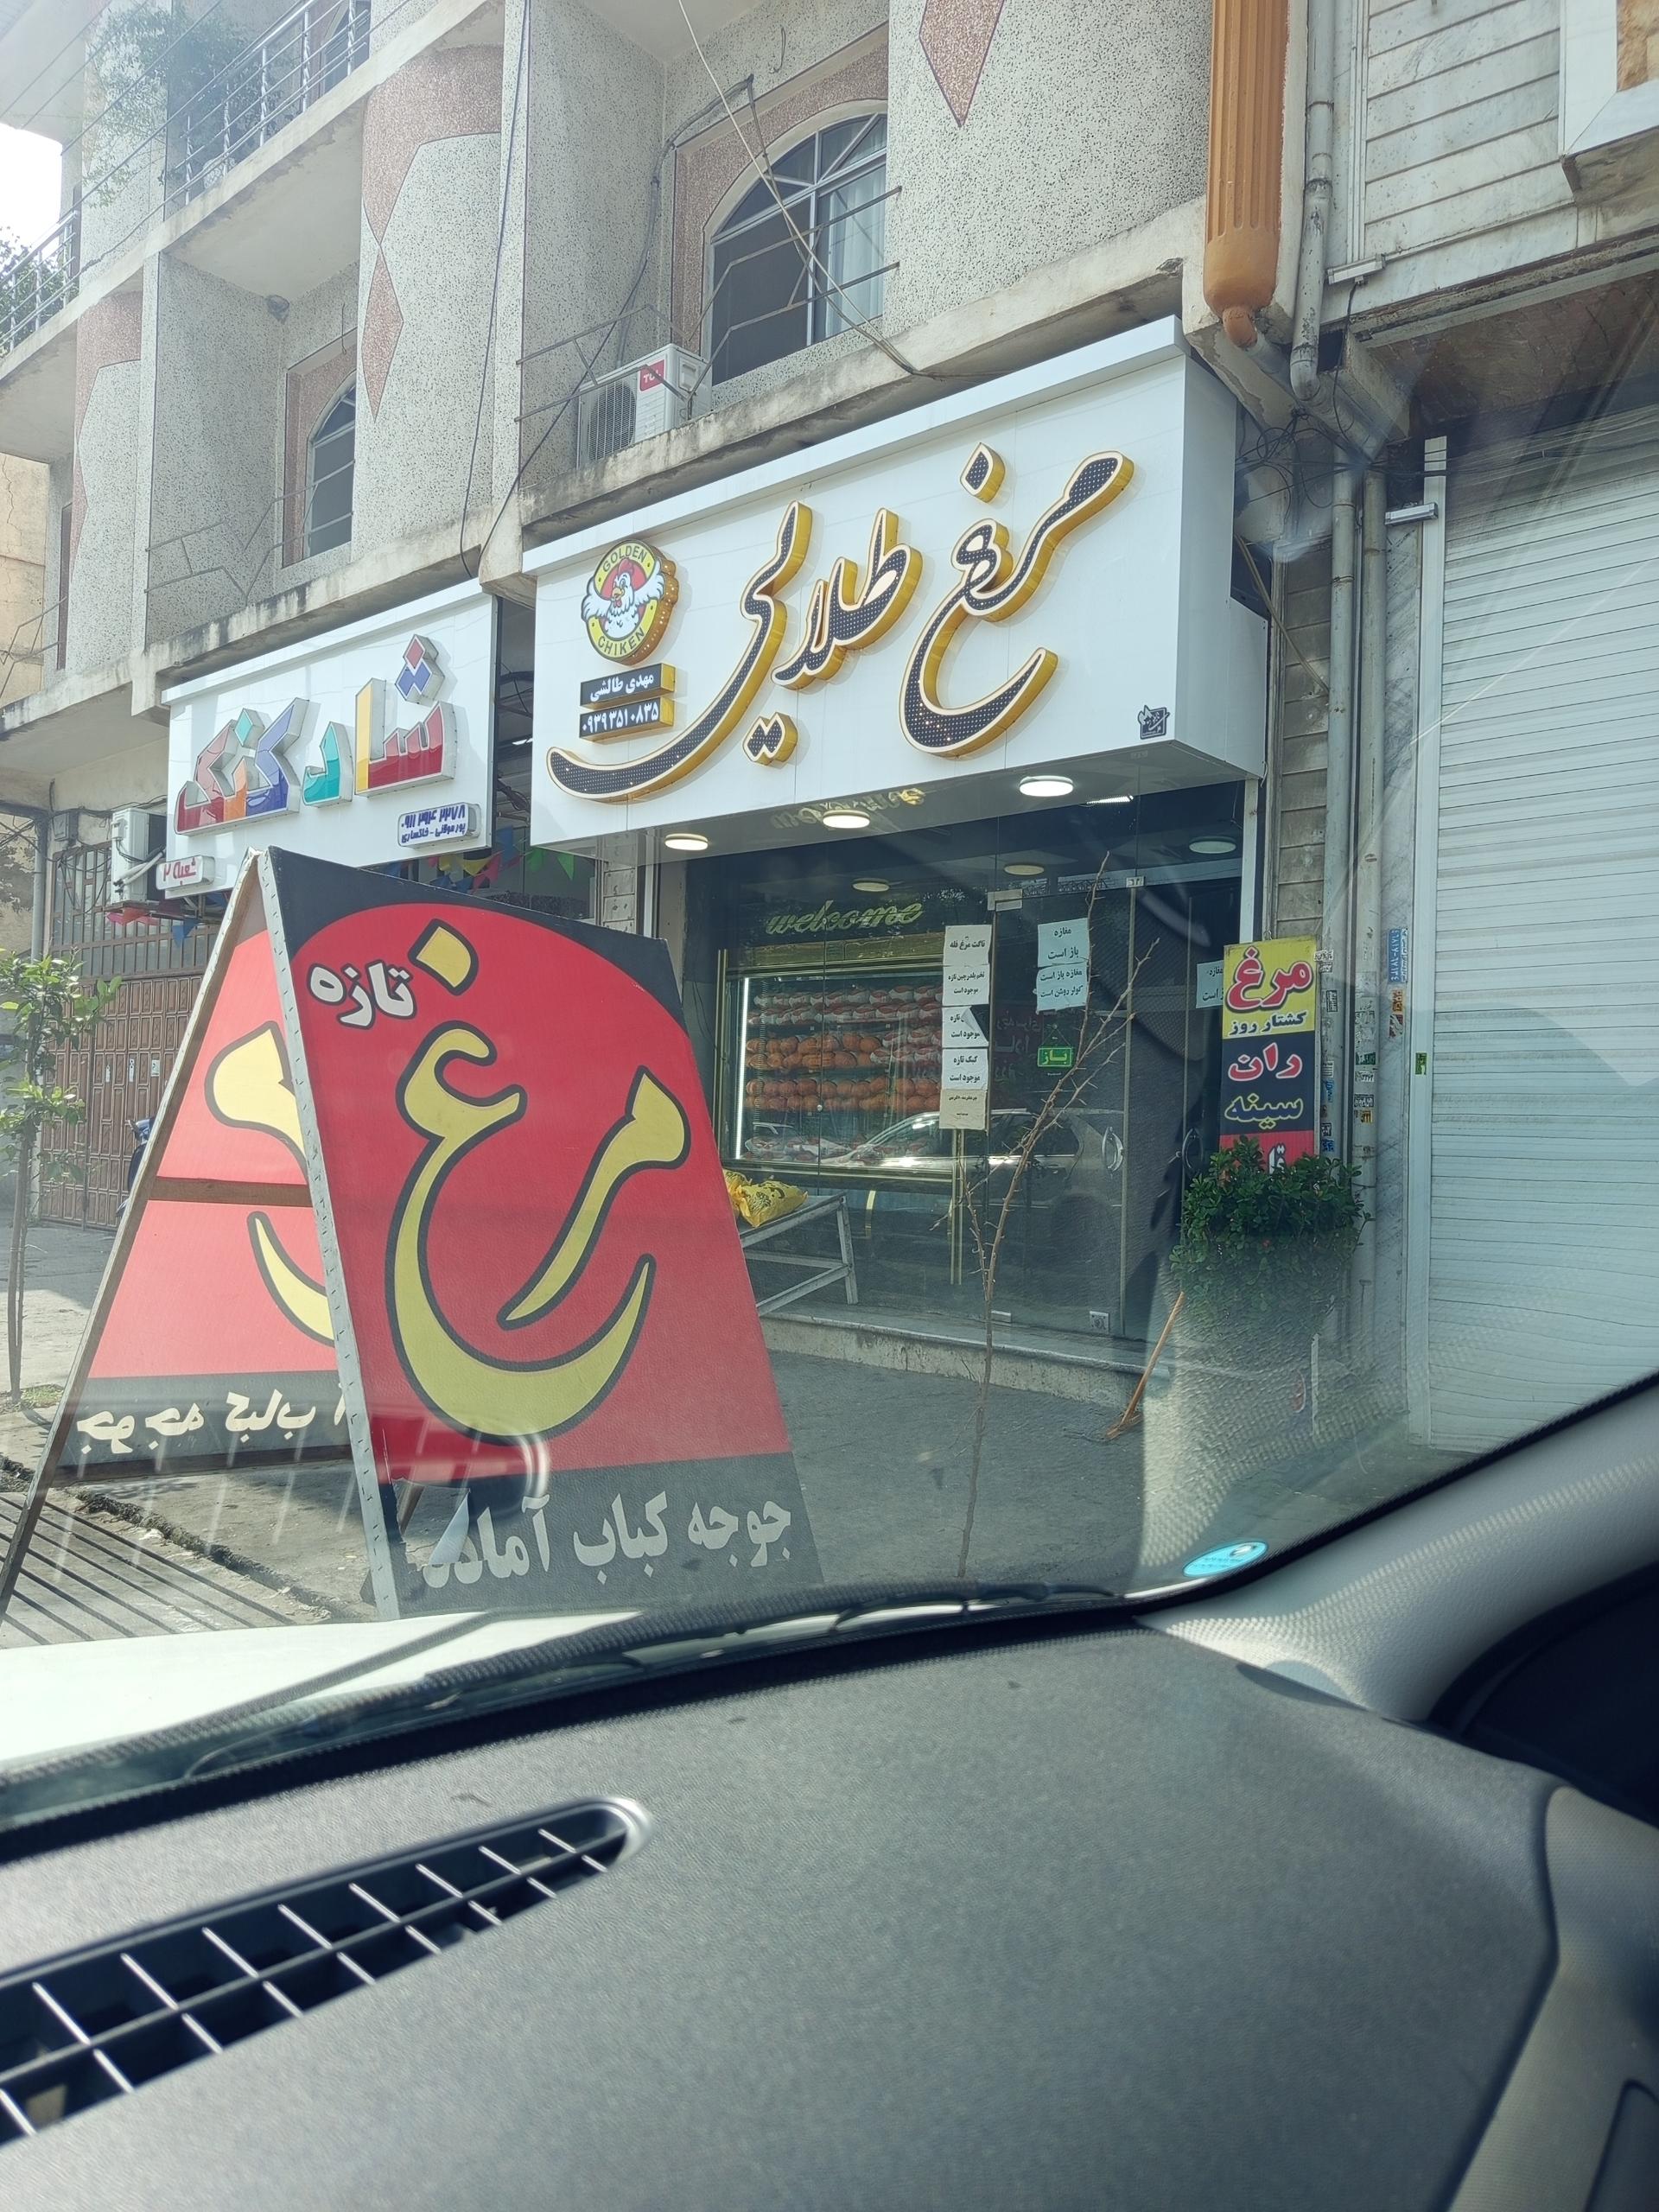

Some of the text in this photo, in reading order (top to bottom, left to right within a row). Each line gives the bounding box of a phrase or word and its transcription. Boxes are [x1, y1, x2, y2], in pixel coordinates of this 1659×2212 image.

[643, 370, 662, 383] TC
[602, 544, 647, 573] GOLDEN
[899, 442, 1134, 760] مرغ
[598, 630, 645, 658] CHIKEN
[590, 674, 654, 702] مهدی طالشی
[766, 899, 925, 935] welcome
[1054, 926, 1071, 938] مغازه
[1048, 946, 1078, 959] باز است
[1040, 971, 1055, 981] است
[1066, 969, 1082, 978] مغازه
[1227, 947, 1313, 1011] مرغ
[308, 961, 416, 1028] تازه
[1040, 989, 1052, 998] است
[1203, 988, 1218, 1001] است
[963, 1031, 980, 1039] موجود
[1230, 1011, 1307, 1035] کشتار روز
[1042, 1049, 1067, 1065] باز
[1224, 1093, 1304, 1129] سینه
[387, 919, 691, 1446] مرغ
[573, 1491, 670, 1585] کباب
[688, 1500, 791, 1567] جوجه
